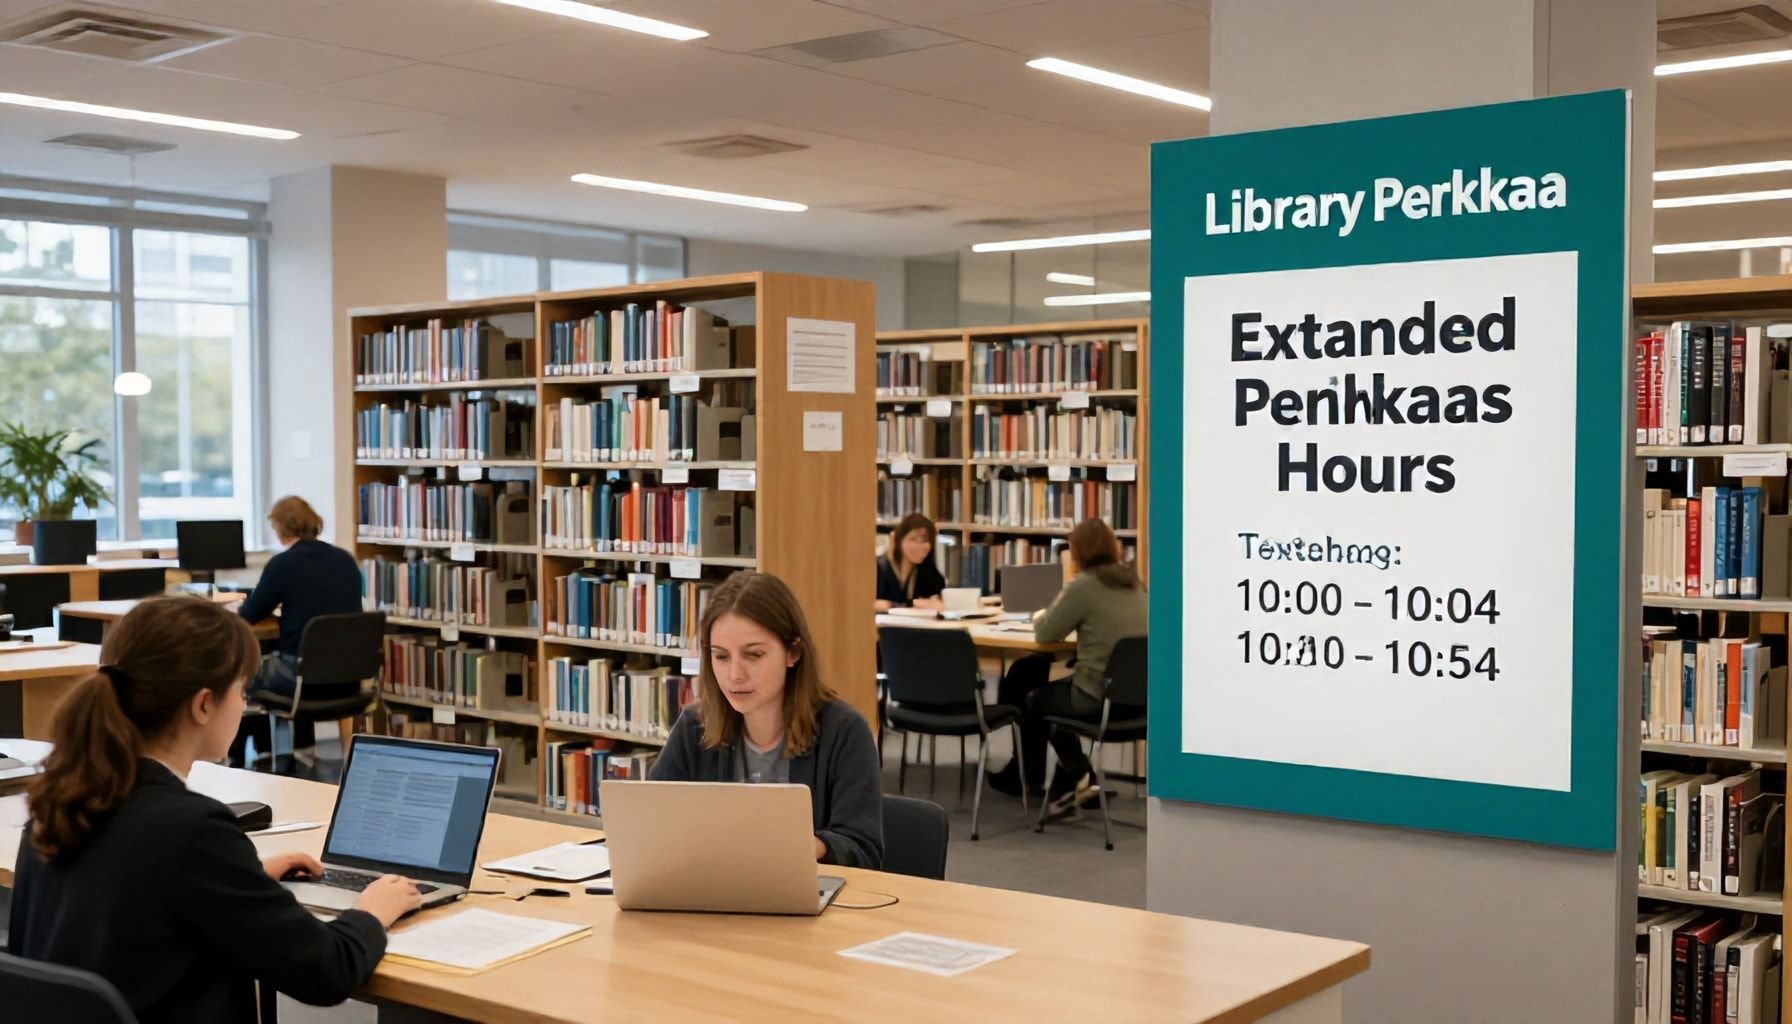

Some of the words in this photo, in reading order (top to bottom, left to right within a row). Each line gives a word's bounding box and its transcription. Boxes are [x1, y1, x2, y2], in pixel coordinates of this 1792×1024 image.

[1205, 188, 1366, 237] Library
[1373, 166, 1567, 222] Perkkaa
[1230, 295, 1516, 362] Extanded
[1278, 442, 1456, 494] Hours
[1237, 578, 1342, 617] 10:00
[1384, 585, 1501, 625] 10:04
[1385, 639, 1501, 682] 10:54
